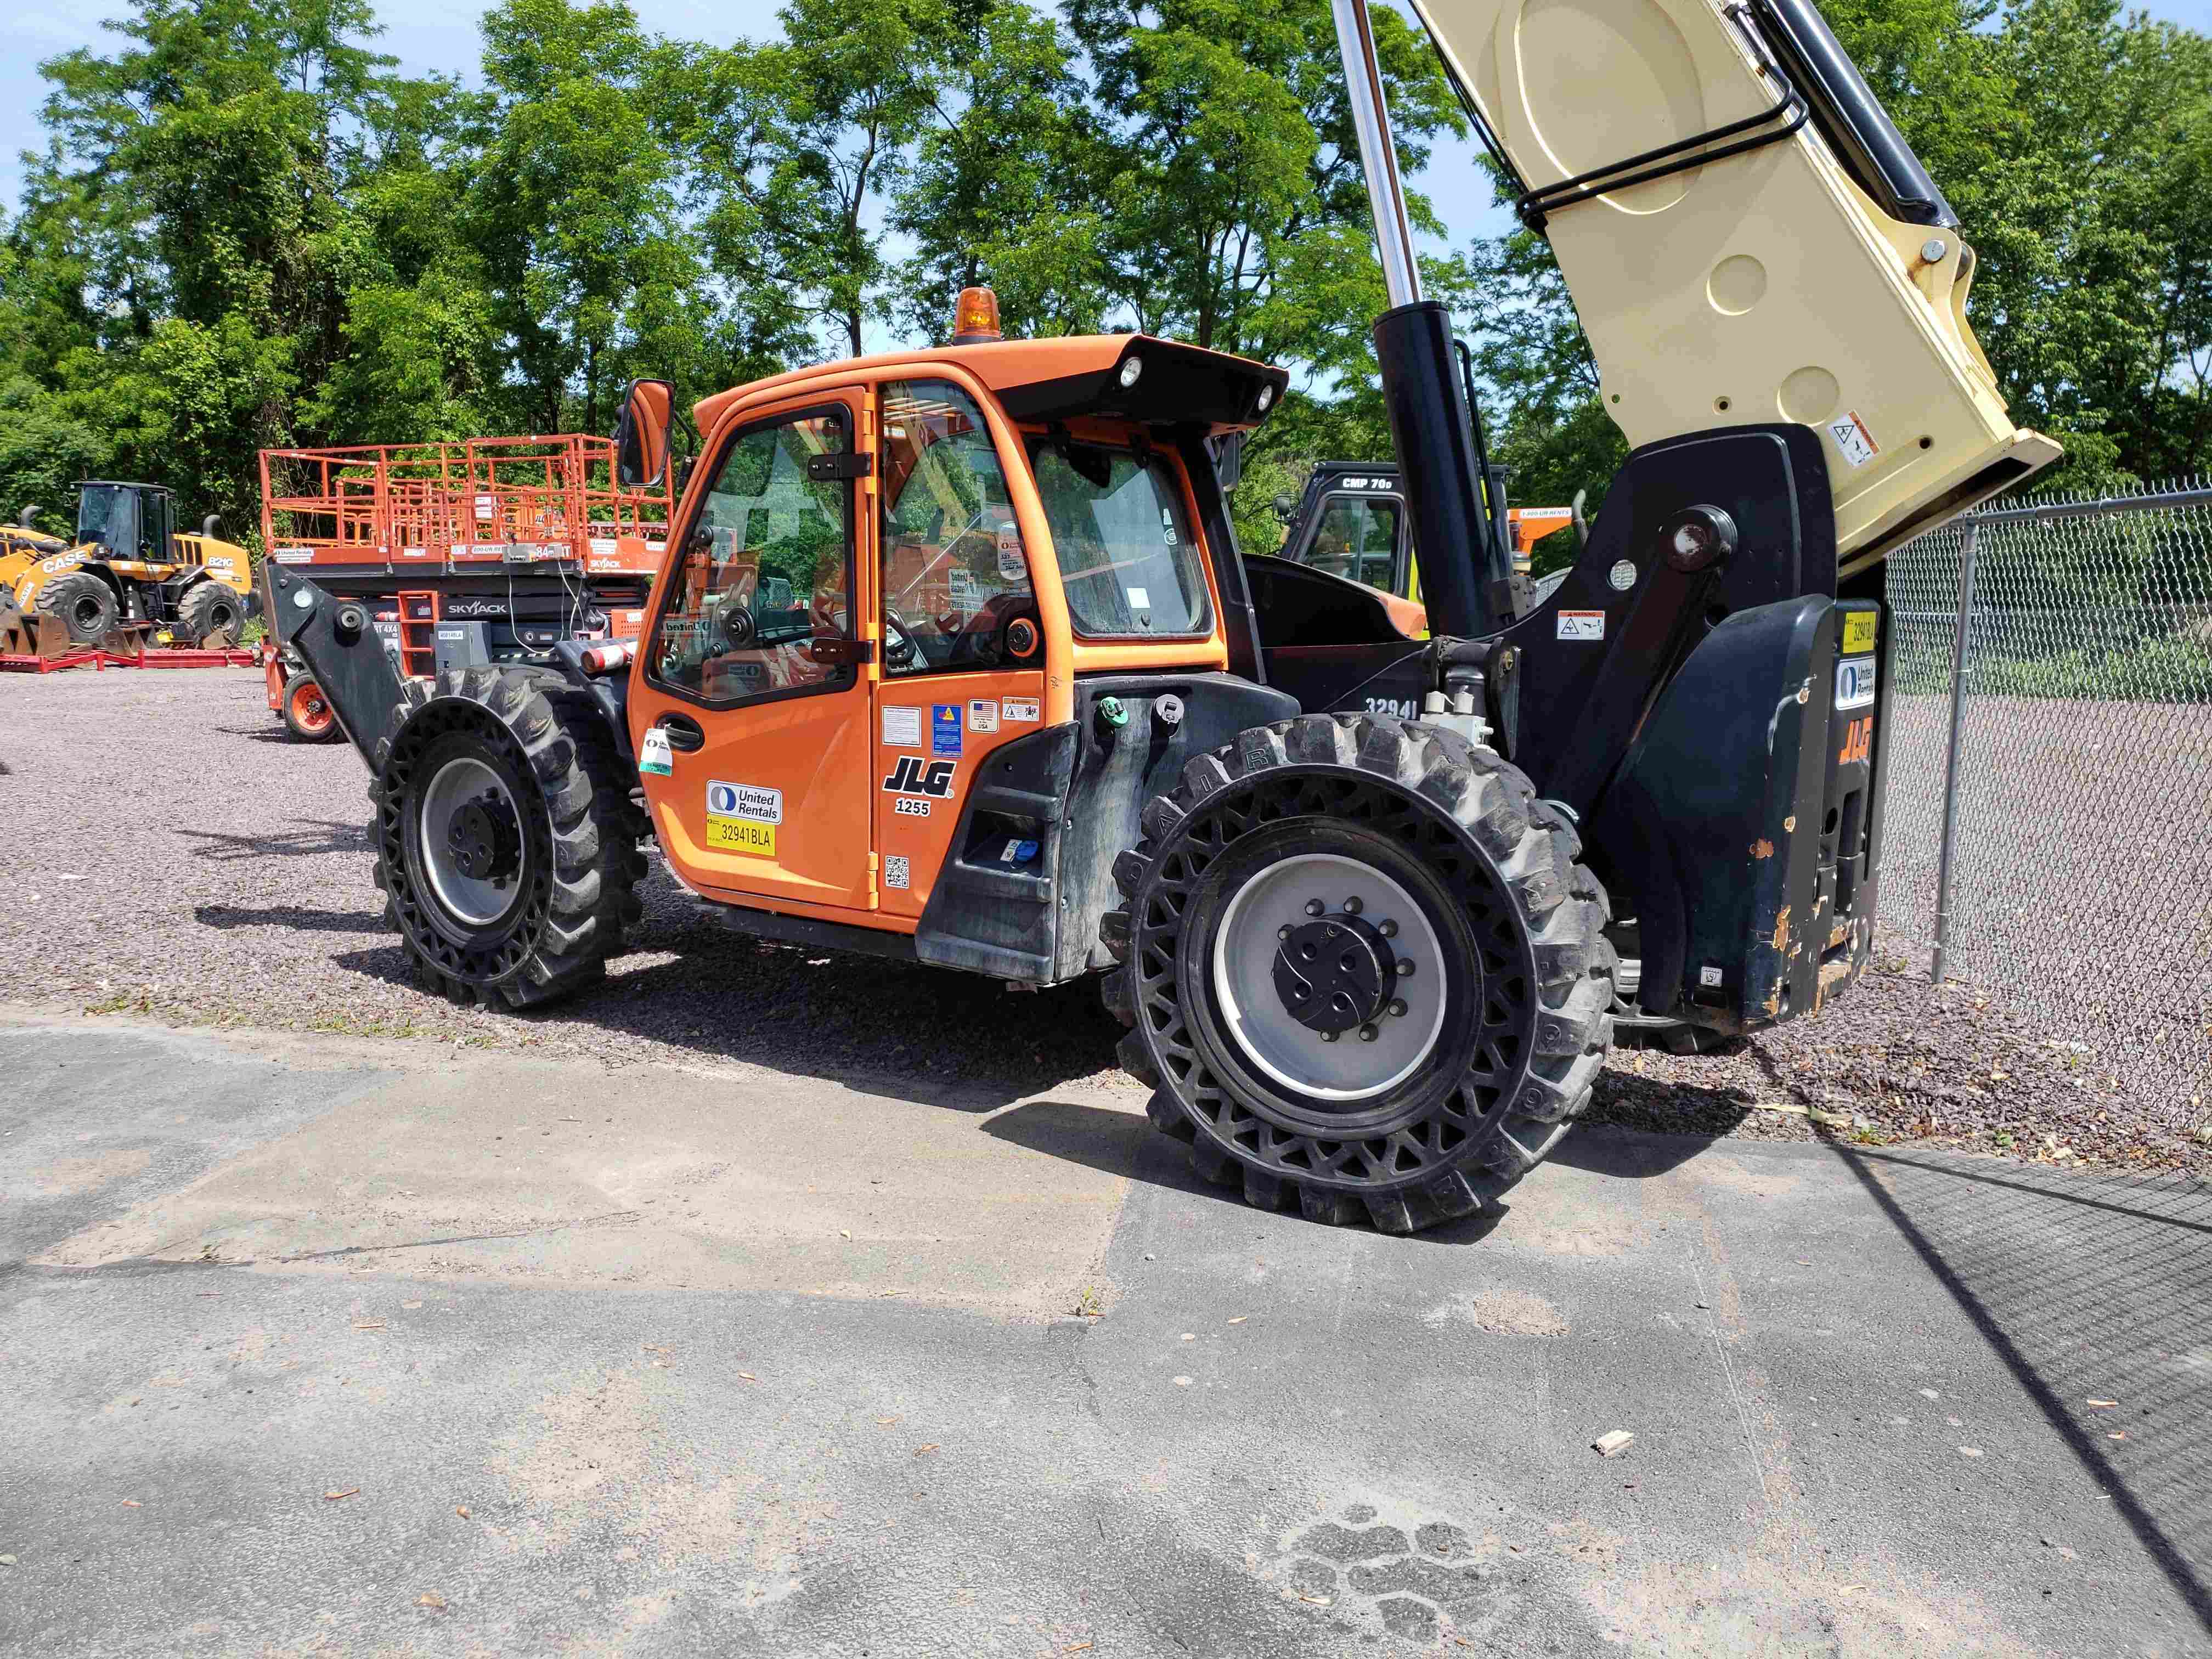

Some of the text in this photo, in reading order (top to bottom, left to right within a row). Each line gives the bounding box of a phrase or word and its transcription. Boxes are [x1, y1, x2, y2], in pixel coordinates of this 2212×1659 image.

[1342, 478, 1368, 488] CMP
[43, 550, 86, 573] CASE
[208, 556, 233, 567] 821G
[590, 557, 620, 569] SKYJACK
[448, 600, 507, 615] SKYJACK
[383, 624, 398, 633] 4X4
[1858, 663, 1873, 681] United
[1858, 681, 1874, 699] Rentals
[1365, 697, 1418, 720] 32941
[1838, 716, 1872, 764] JLG
[883, 756, 956, 798] JLG
[739, 789, 775, 806] United
[738, 803, 778, 819] Rentals
[896, 799, 929, 815] 1255
[721, 824, 771, 848] 32941BLA
